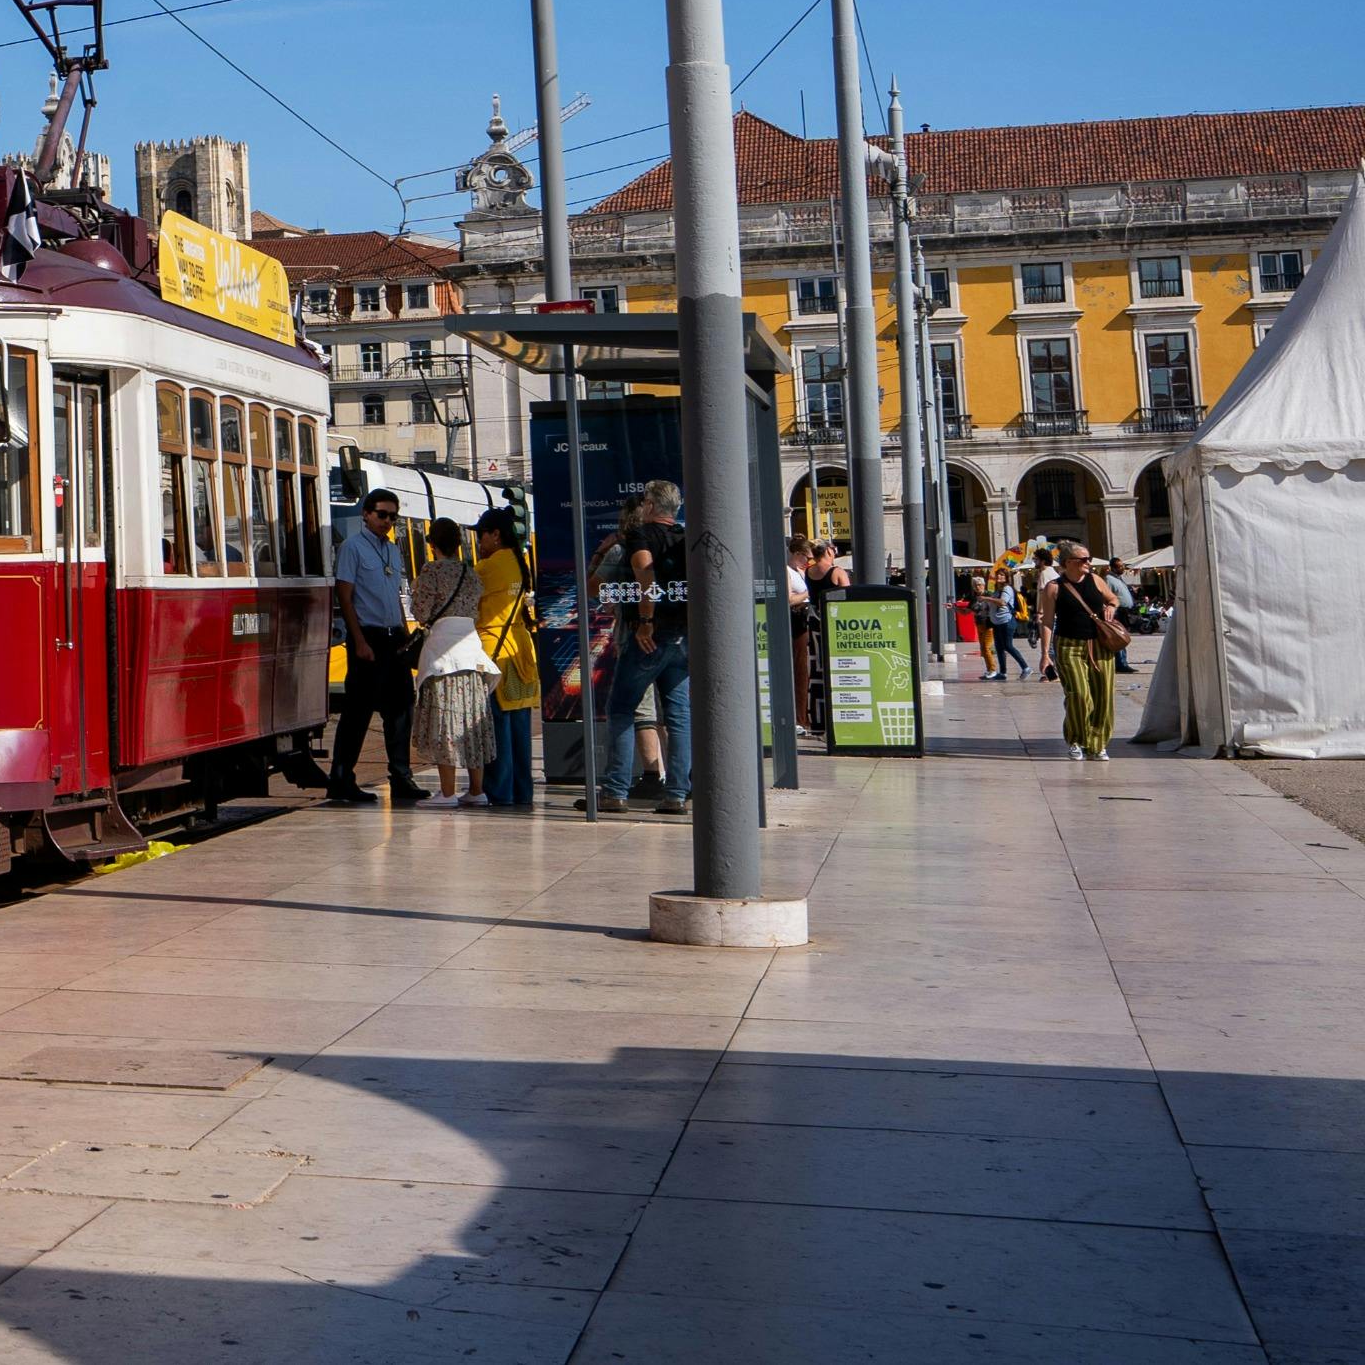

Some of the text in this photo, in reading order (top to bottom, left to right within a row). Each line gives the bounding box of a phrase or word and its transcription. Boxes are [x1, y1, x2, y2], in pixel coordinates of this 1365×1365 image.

[817, 492, 844, 500] MUSEU
[835, 619, 882, 631] NOVA
[836, 631, 883, 642] Papeleira
[836, 640, 897, 649] INTELIGENTE
